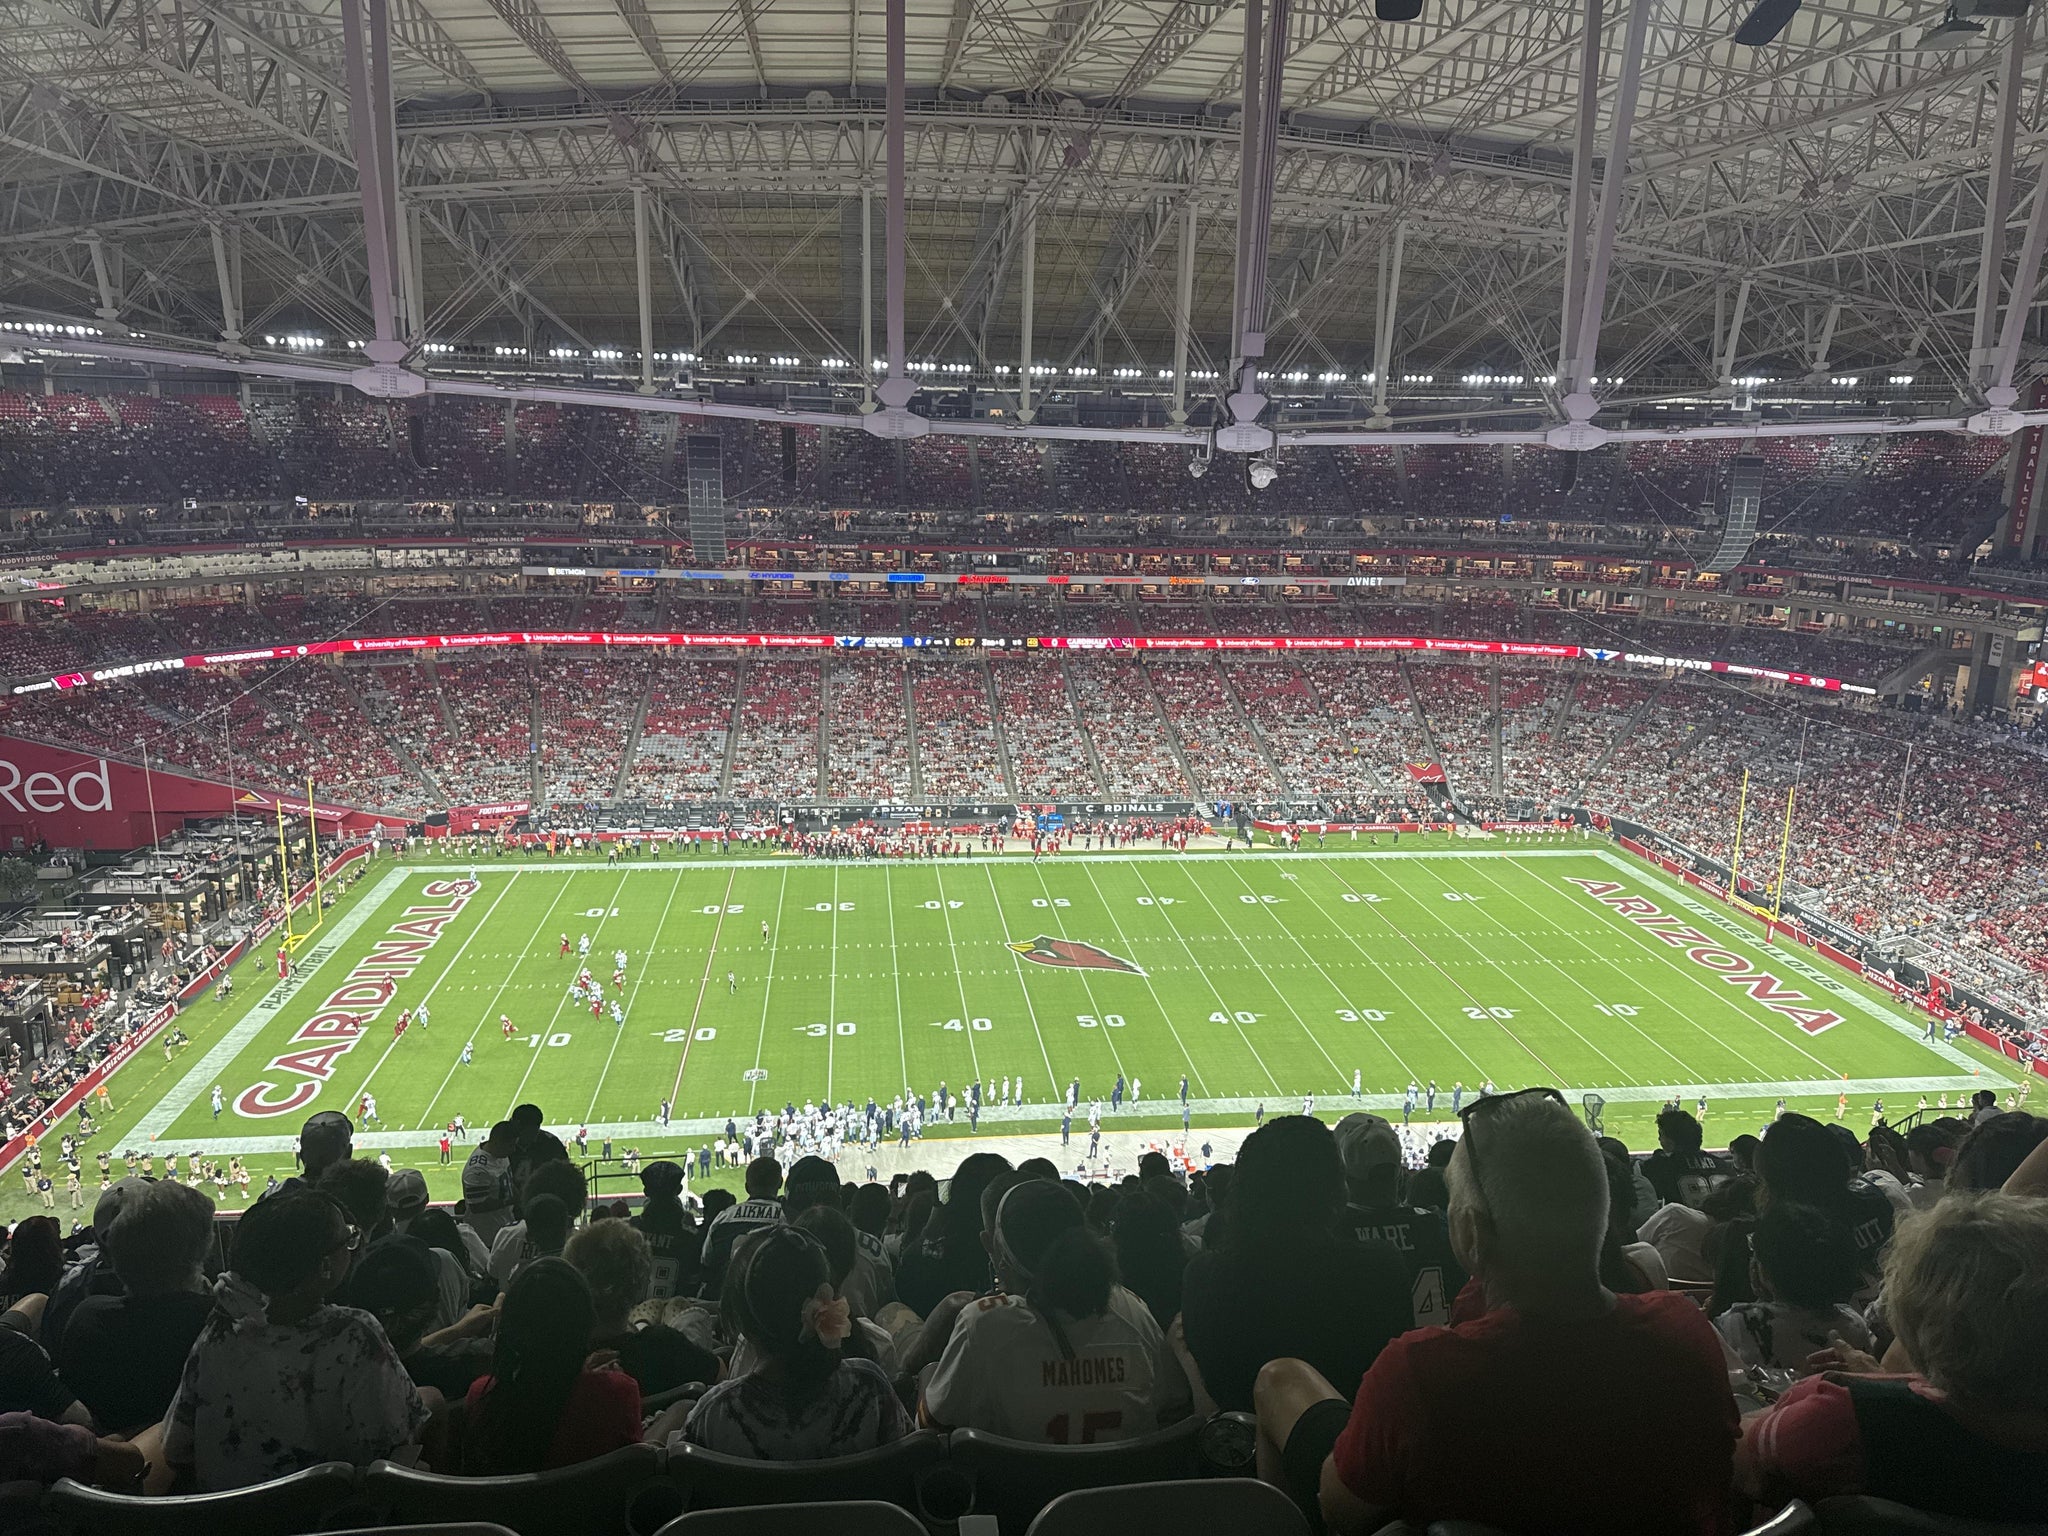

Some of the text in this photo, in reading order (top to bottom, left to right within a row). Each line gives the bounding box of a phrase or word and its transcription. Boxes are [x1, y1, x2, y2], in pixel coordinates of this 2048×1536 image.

[25, 554, 59, 563] DRISCOLL
[556, 568, 586, 576] BETMGM
[1803, 571, 1873, 585] MARSHALL GOLDBERG
[1346, 577, 1383, 586] AVNET
[364, 640, 394, 648] University
[955, 638, 975, 646] 6:37
[1051, 638, 1058, 646] 0
[204, 651, 274, 663] TOUCHDOWNS
[296, 645, 308, 655] 0
[1624, 653, 1712, 671] GAME STATS
[93, 659, 185, 682] GAME STATS
[1809, 677, 1827, 688] 10
[0, 759, 112, 813] Red
[280, 802, 342, 817] verion
[1085, 803, 1164, 812] CRDINALS
[1698, 880, 1724, 898] ARIZONA
[1800, 910, 1862, 947] ARIZONA CARDINALS
[1561, 876, 1847, 1037] ARIZONA
[1704, 911, 1756, 944] TAKES
[1755, 940, 1786, 959] ALL
[1783, 958, 1809, 974] OF
[1812, 974, 1845, 992] US
[231, 878, 482, 1119] CARDINALS
[1208, 1010, 1258, 1024] 40
[1335, 1008, 1386, 1022] 30
[1461, 1006, 1513, 1020] 20
[1593, 1003, 1640, 1017] 10
[943, 1017, 993, 1032] 40
[1077, 1014, 1126, 1028] 50
[662, 1027, 717, 1042] 20
[806, 1022, 857, 1036] 30
[101, 1010, 169, 1076] ARIZONA CARDINALS
[528, 1033, 573, 1048] 10
[469, 1155, 488, 1166] 88
[733, 1206, 782, 1219] AIKMAN
[1355, 1223, 1416, 1251] WARE
[1042, 1357, 1125, 1387] MAHOMES
